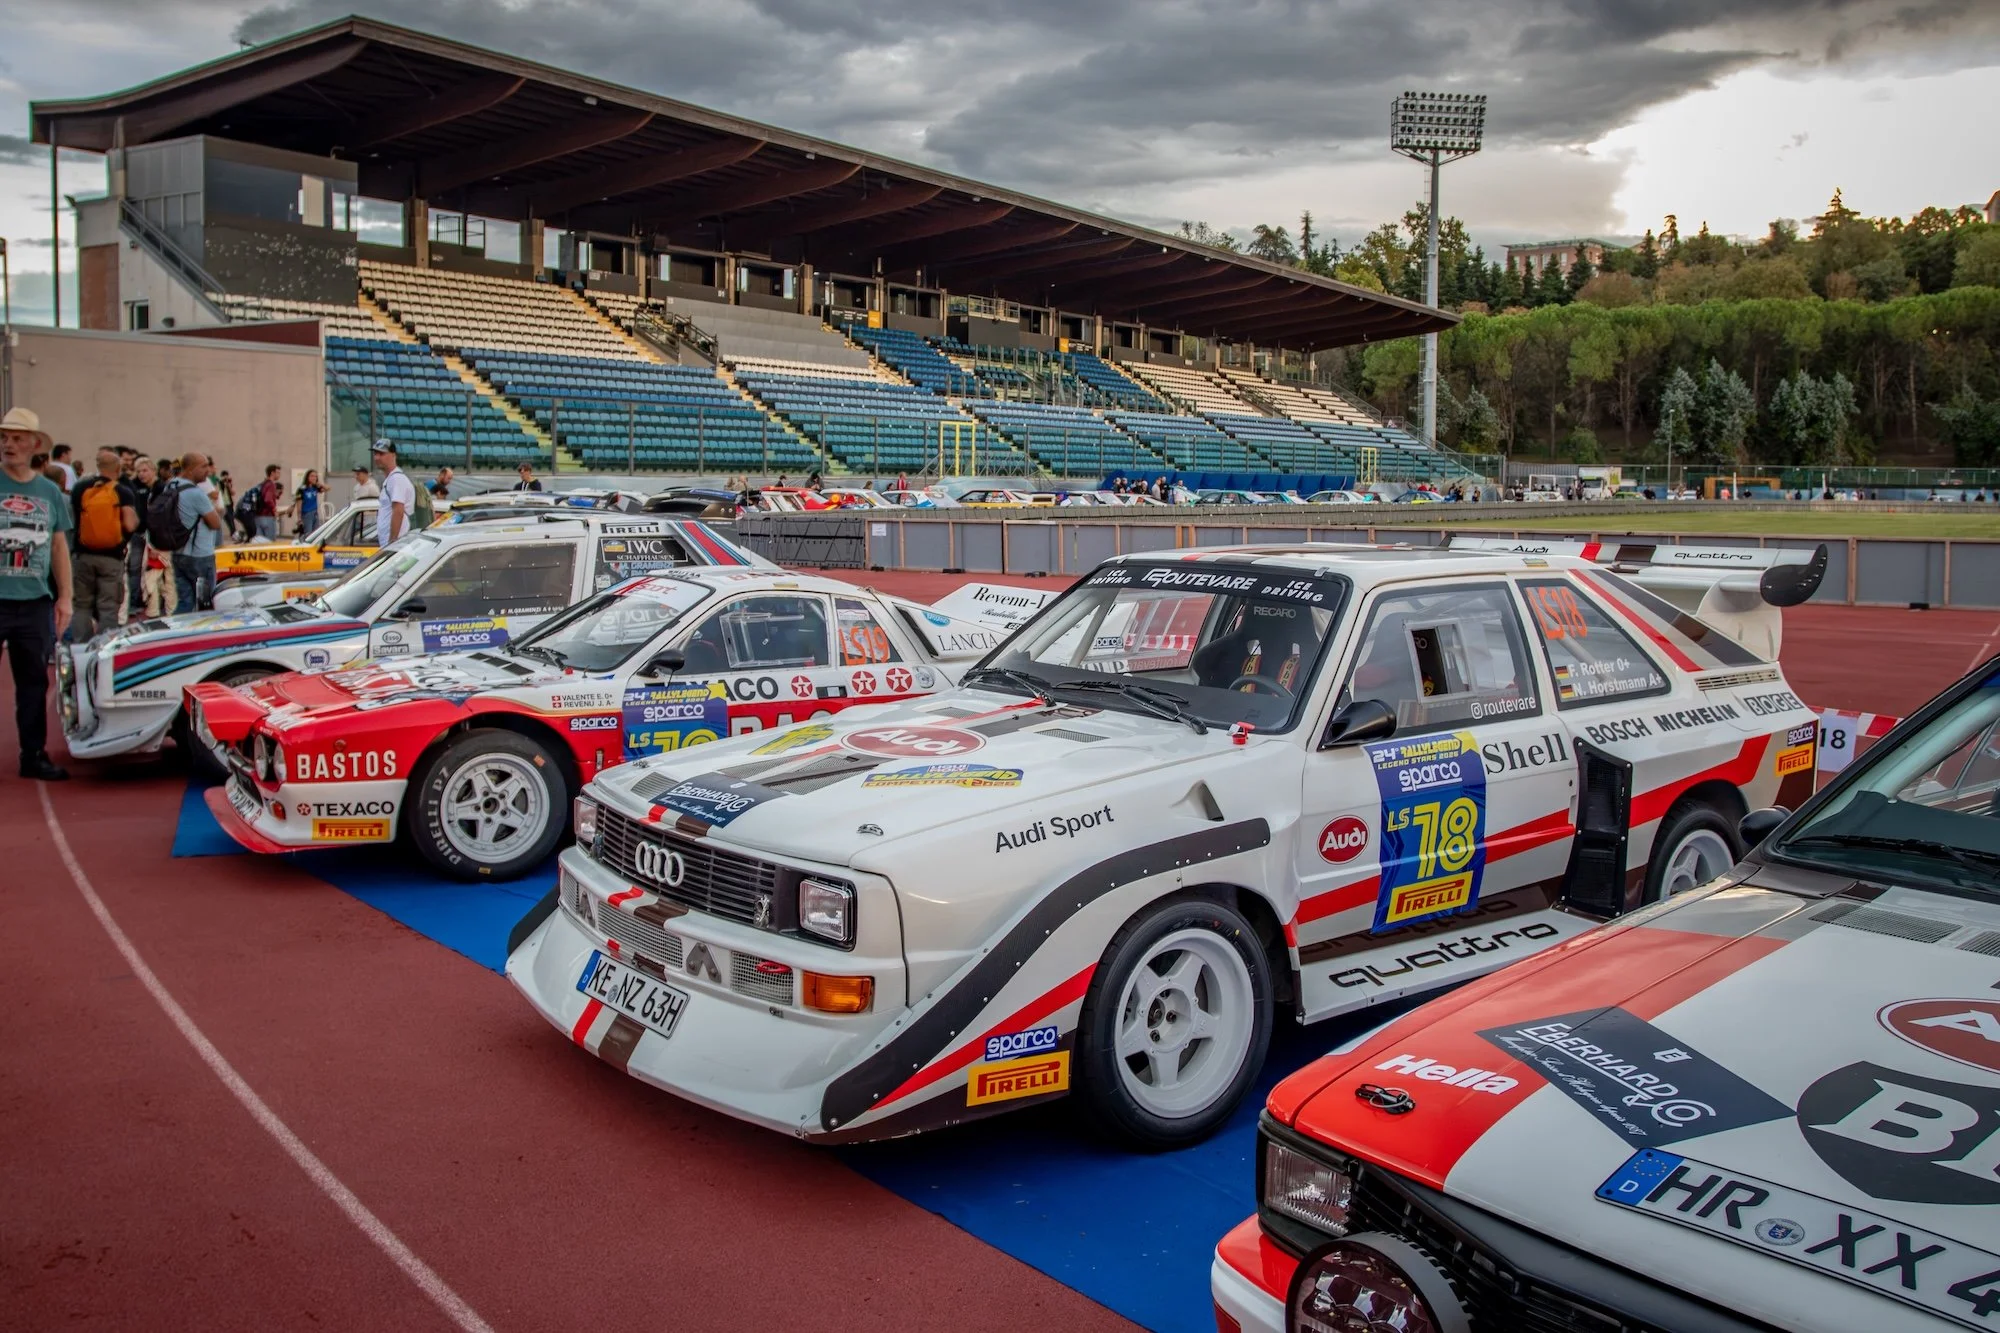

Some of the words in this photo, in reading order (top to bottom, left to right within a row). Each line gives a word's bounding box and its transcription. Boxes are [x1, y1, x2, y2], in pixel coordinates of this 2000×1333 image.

[601, 523, 660, 533] PIRELLI
[626, 540, 663, 554] IWC
[1512, 545, 1549, 554] Audi
[1674, 552, 1753, 560] quattro
[1088, 576, 1132, 585] DRIVING
[1107, 569, 1127, 577] ICE
[1141, 568, 1257, 590] ROUTEVARE
[1261, 586, 1323, 602] DRIVING
[1286, 580, 1313, 591] ICE
[1253, 606, 1297, 619] RECARO
[1524, 586, 1587, 640] LS18
[440, 633, 491, 647] sparco
[838, 625, 891, 666] LS19
[938, 633, 999, 651] LANCIA
[1095, 637, 1123, 649] parco
[1568, 665, 1580, 678] F.
[1580, 661, 1615, 677] Rotter
[131, 690, 167, 699] WEBER
[1573, 683, 1587, 697] N.
[1588, 677, 1648, 695] Horstmann
[1649, 673, 1663, 687] A+
[644, 704, 705, 723] sparco
[1484, 695, 1537, 717] routevare
[1744, 692, 1804, 717] BOGE
[570, 716, 618, 731] sparco
[1653, 704, 1740, 733] MICHELIN
[628, 732, 651, 749] LS
[857, 728, 968, 755] Audi
[1585, 718, 1652, 745] BOSCH
[1787, 725, 1814, 746] sparco
[297, 749, 397, 779] BASTOS
[1378, 759, 1409, 770] LEGEND
[1411, 754, 1437, 763] STARS
[1482, 733, 1569, 775] Shell
[1777, 749, 1810, 772] PIRELLI
[432, 766, 450, 792] P7
[1398, 761, 1463, 792] sparco
[667, 782, 738, 803] EBERHARD
[312, 801, 395, 816] TEXACO
[318, 823, 383, 838] PIRELLI
[427, 800, 462, 865] PIRELLI
[996, 820, 1048, 854] Audi
[1049, 804, 1115, 838] Sport
[1321, 828, 1367, 852] Audi
[1387, 807, 1411, 832] LS
[1413, 797, 1479, 879] 18
[1395, 878, 1466, 915] PIRELLI
[1328, 922, 1560, 987] quattro
[588, 959, 617, 997] KE
[615, 972, 647, 1013] NZ
[641, 987, 684, 1032] 63H
[986, 1027, 1057, 1060] sparco
[1520, 1023, 1680, 1100] EBERHARD
[976, 1061, 1061, 1098] PIRELLI
[1374, 1052, 1520, 1095] Hella
[1618, 1180, 1640, 1193] D
[1644, 1164, 1771, 1230] HR
[1803, 1212, 1947, 1291] XX
